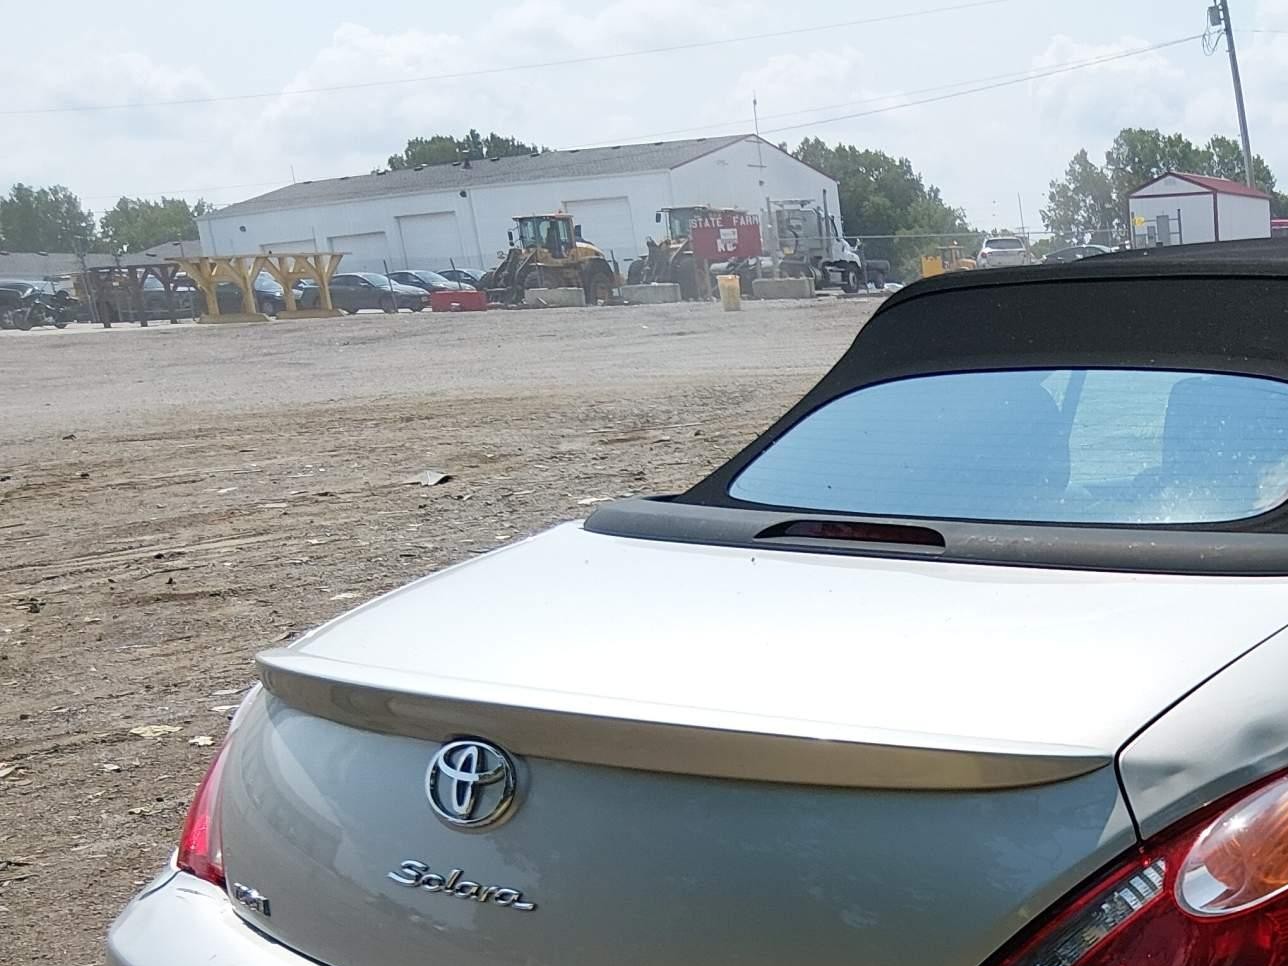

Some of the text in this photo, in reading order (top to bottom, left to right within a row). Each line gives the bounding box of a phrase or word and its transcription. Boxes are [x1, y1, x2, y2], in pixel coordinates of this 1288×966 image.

[691, 215, 760, 229] STATE FARM
[386, 859, 538, 912] Solara
